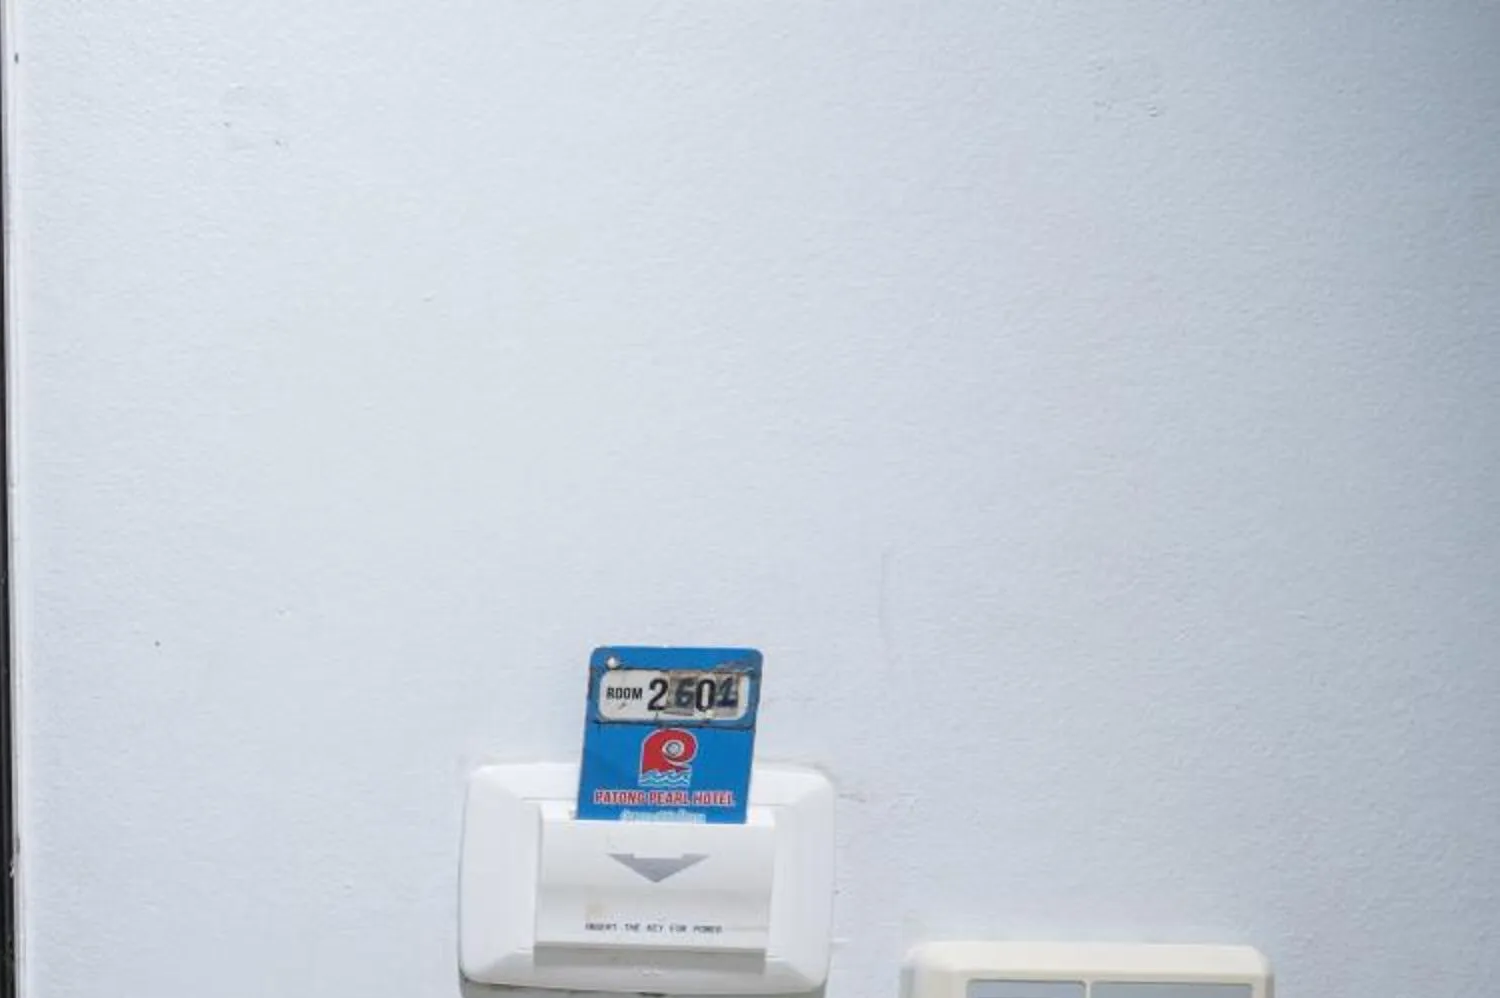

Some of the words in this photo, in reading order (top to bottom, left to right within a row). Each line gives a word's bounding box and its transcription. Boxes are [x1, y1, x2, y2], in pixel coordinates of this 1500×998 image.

[606, 686, 643, 701] ROOM
[594, 790, 644, 805] PATONG
[648, 790, 690, 806] PEARL
[693, 790, 734, 806] HOTEL
[624, 922, 640, 932] THE
[646, 923, 664, 933] KEY
[669, 924, 688, 933] FOR
